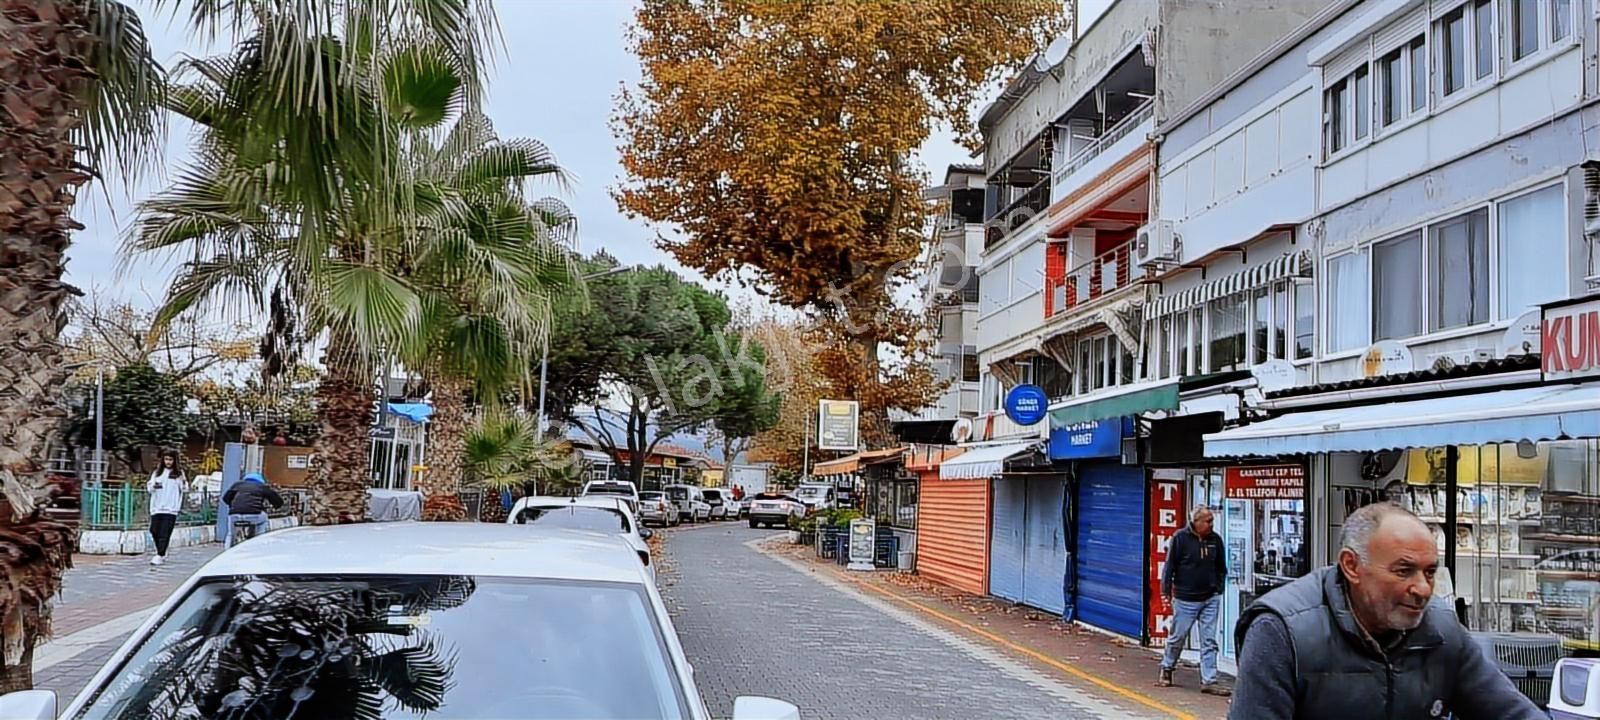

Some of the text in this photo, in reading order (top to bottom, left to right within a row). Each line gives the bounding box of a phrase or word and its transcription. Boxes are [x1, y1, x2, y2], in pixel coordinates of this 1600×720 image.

[1070, 433, 1092, 446] MARKET
[1276, 468, 1288, 477] CEP
[1229, 488, 1235, 497] 2.
[1236, 488, 1245, 497] EL
[1246, 488, 1276, 498] TELEFON
